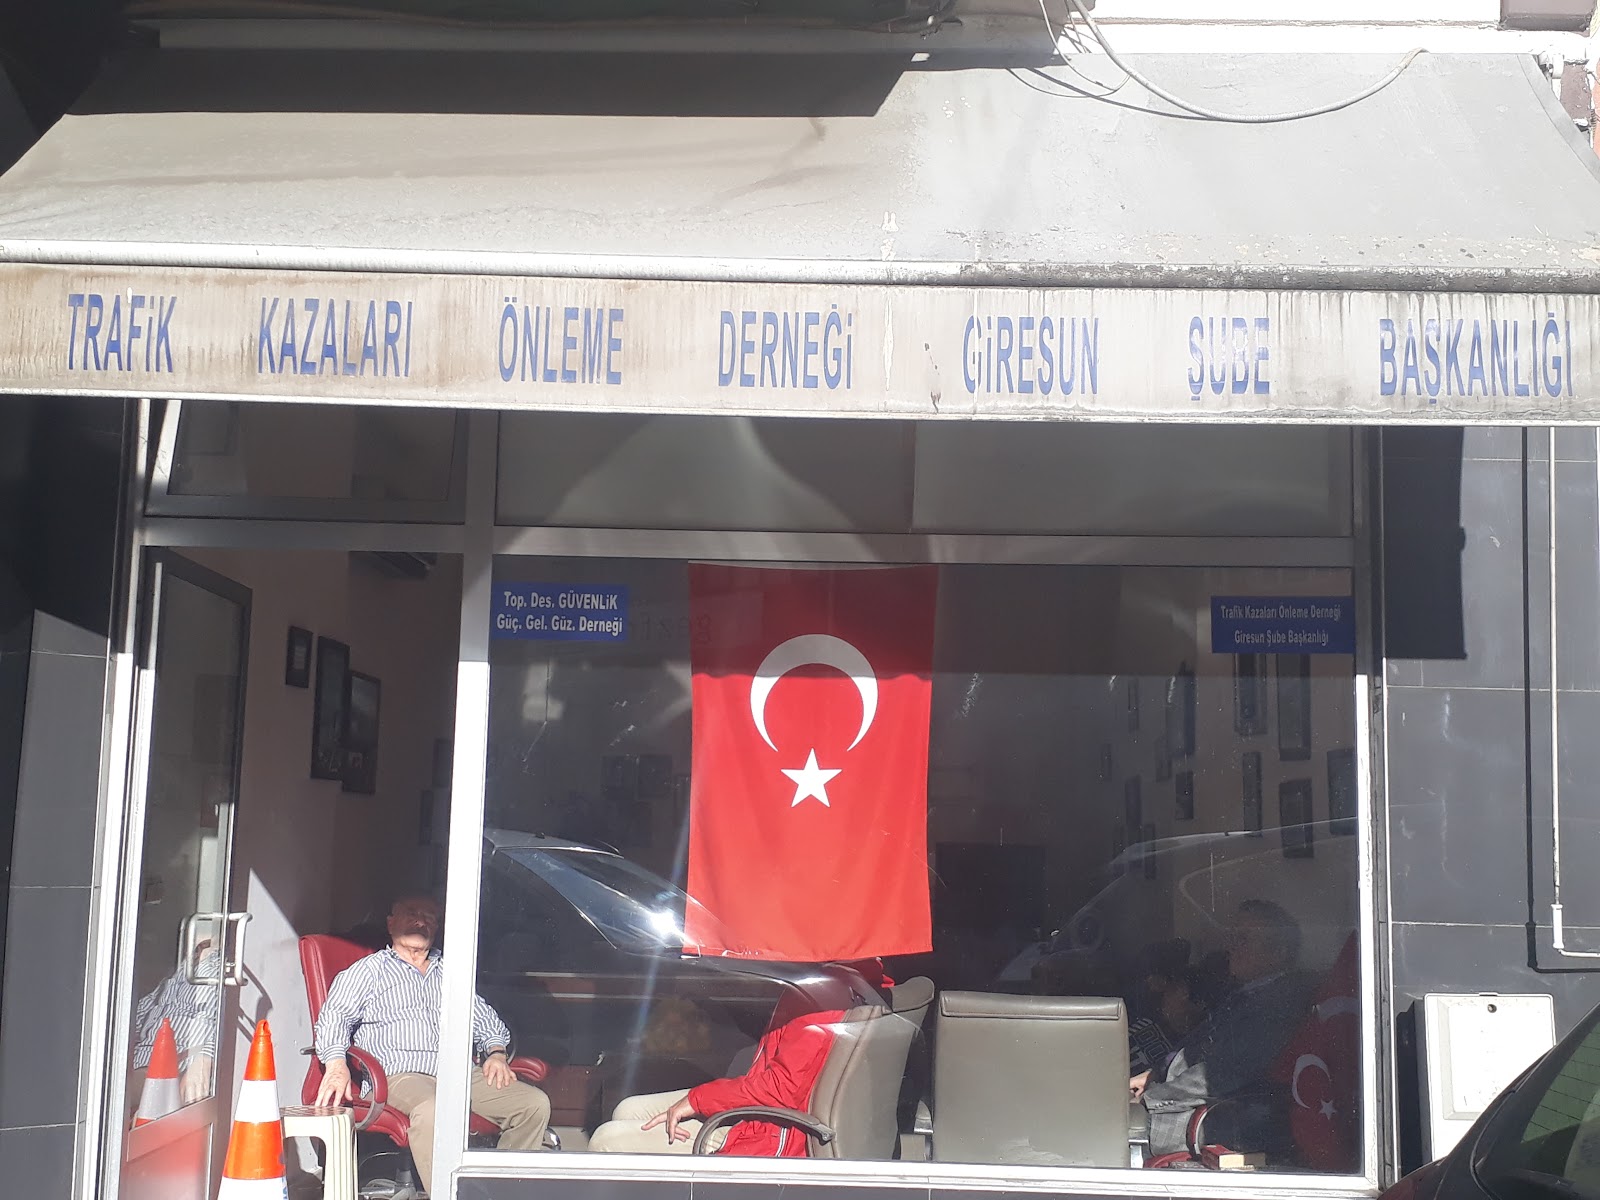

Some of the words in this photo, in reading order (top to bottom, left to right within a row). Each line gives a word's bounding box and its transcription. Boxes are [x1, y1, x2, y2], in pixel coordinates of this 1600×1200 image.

[258, 296, 413, 377] KAZALARI
[498, 296, 625, 386] ÖNLEME
[1187, 315, 1271, 401] ŞUBE
[1379, 312, 1574, 405] BAŞKANLIĞI
[504, 591, 527, 610] Top.
[531, 592, 555, 608] Des.
[1220, 605, 1244, 619] Trafik
[1245, 605, 1277, 619] Kazaları
[1278, 602, 1308, 619] Önleme
[1311, 604, 1342, 621] Derneği
[496, 613, 522, 633] Güç.
[525, 615, 548, 631] Gel.
[551, 615, 576, 631] Güz.
[579, 616, 623, 636] Derneği
[1234, 630, 1265, 644] Giresun
[1266, 630, 1287, 647] Şube
[1288, 629, 1329, 647] Başkanlığı
